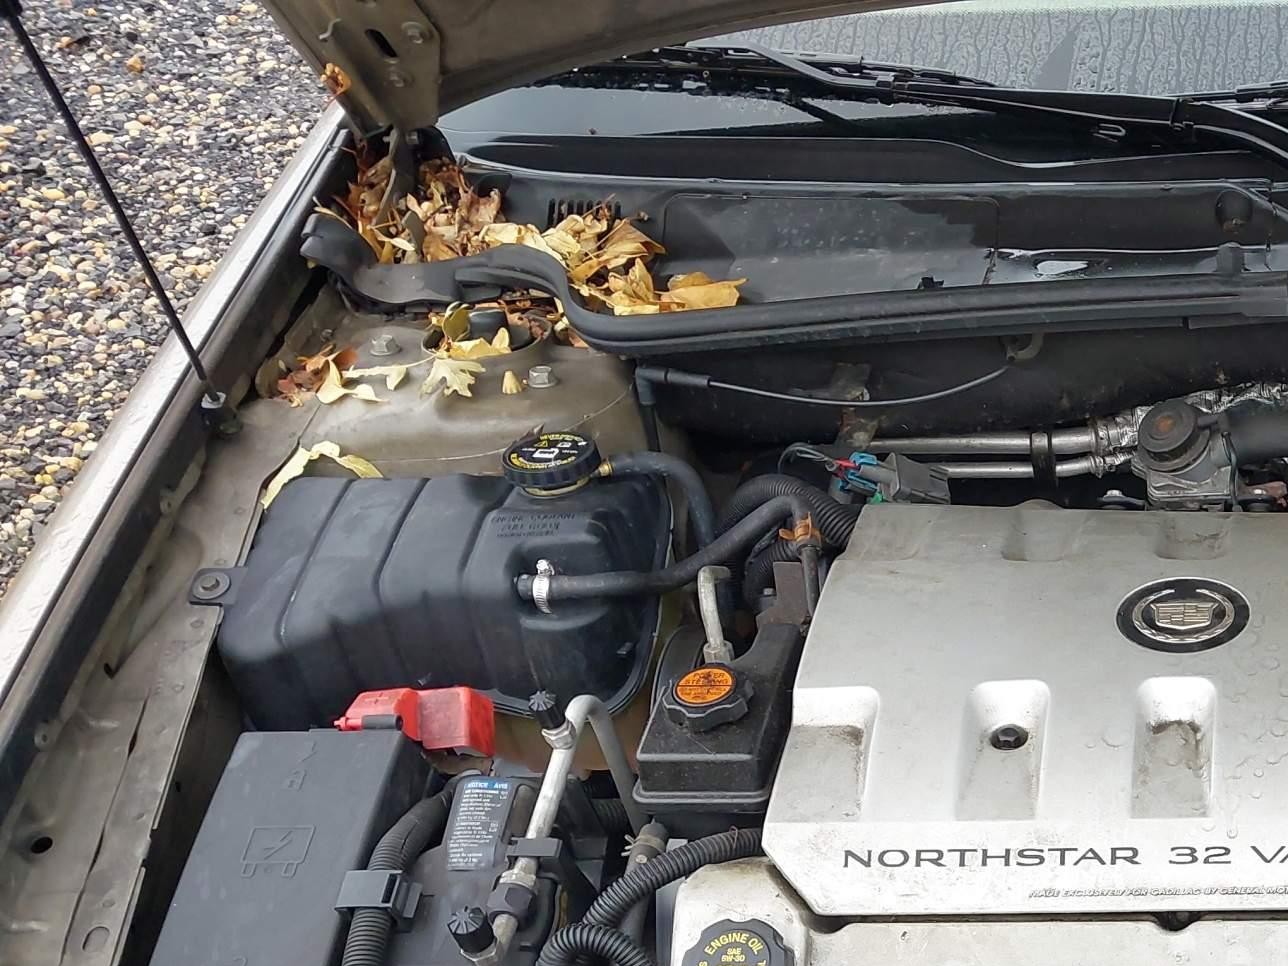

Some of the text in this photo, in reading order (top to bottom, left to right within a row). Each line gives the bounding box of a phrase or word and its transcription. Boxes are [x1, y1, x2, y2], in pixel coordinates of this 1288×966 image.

[843, 846, 1140, 868] NORTHSTAR
[1168, 845, 1232, 865] 32
[1150, 886, 1202, 897] CADILLAC
[704, 932, 765, 956] ENGINE OIL
[721, 954, 746, 962] 5W-30
